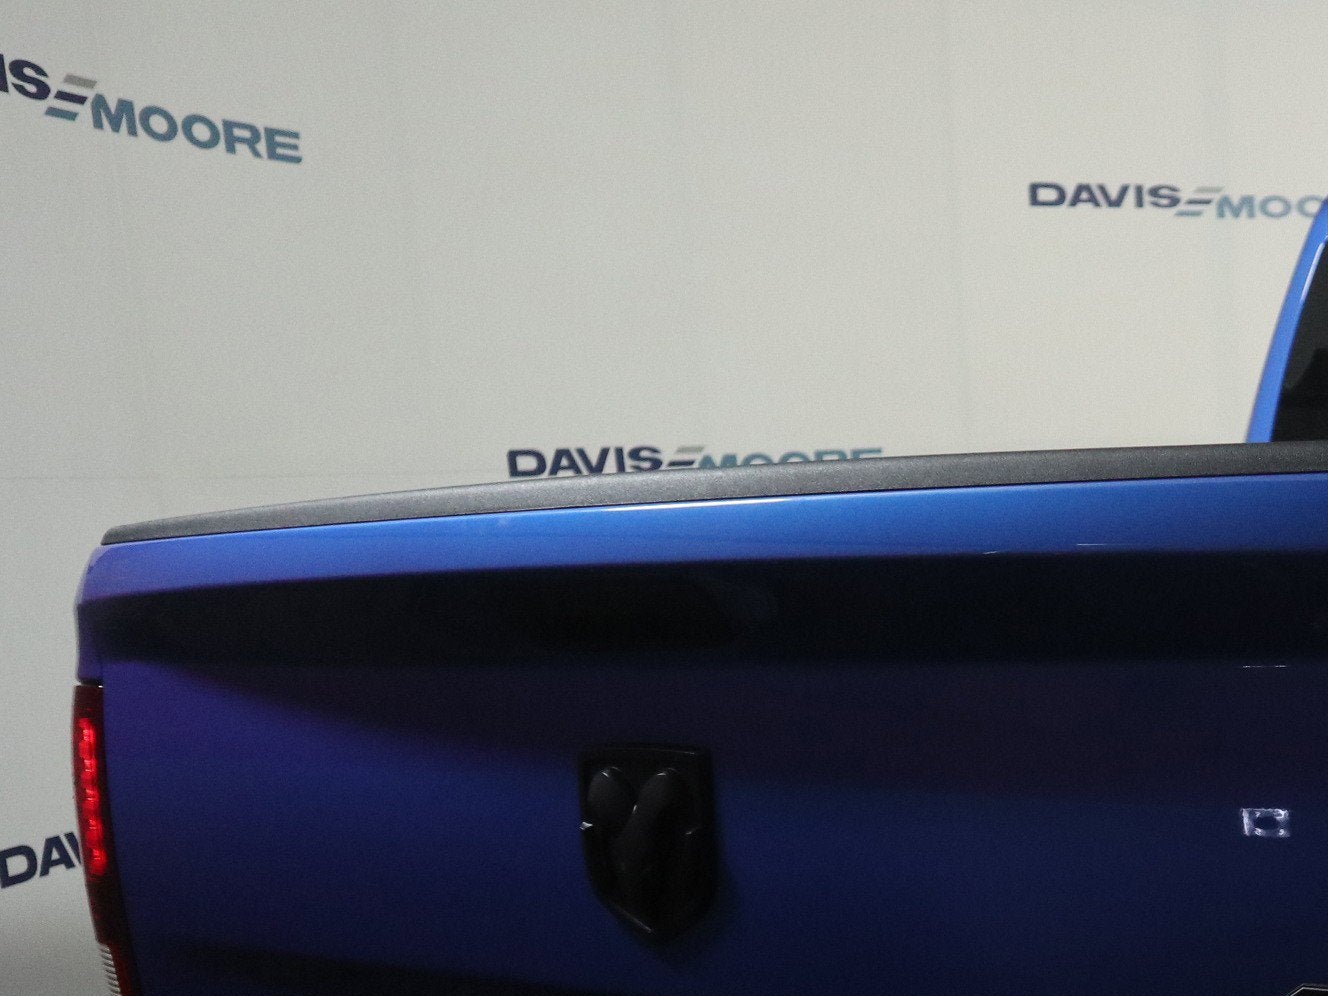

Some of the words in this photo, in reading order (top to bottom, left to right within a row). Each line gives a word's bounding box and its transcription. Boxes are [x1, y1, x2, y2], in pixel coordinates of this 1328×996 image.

[90, 92, 303, 164] MOORE
[1028, 182, 1182, 208] DAVIS
[506, 446, 664, 478] DAVIS
